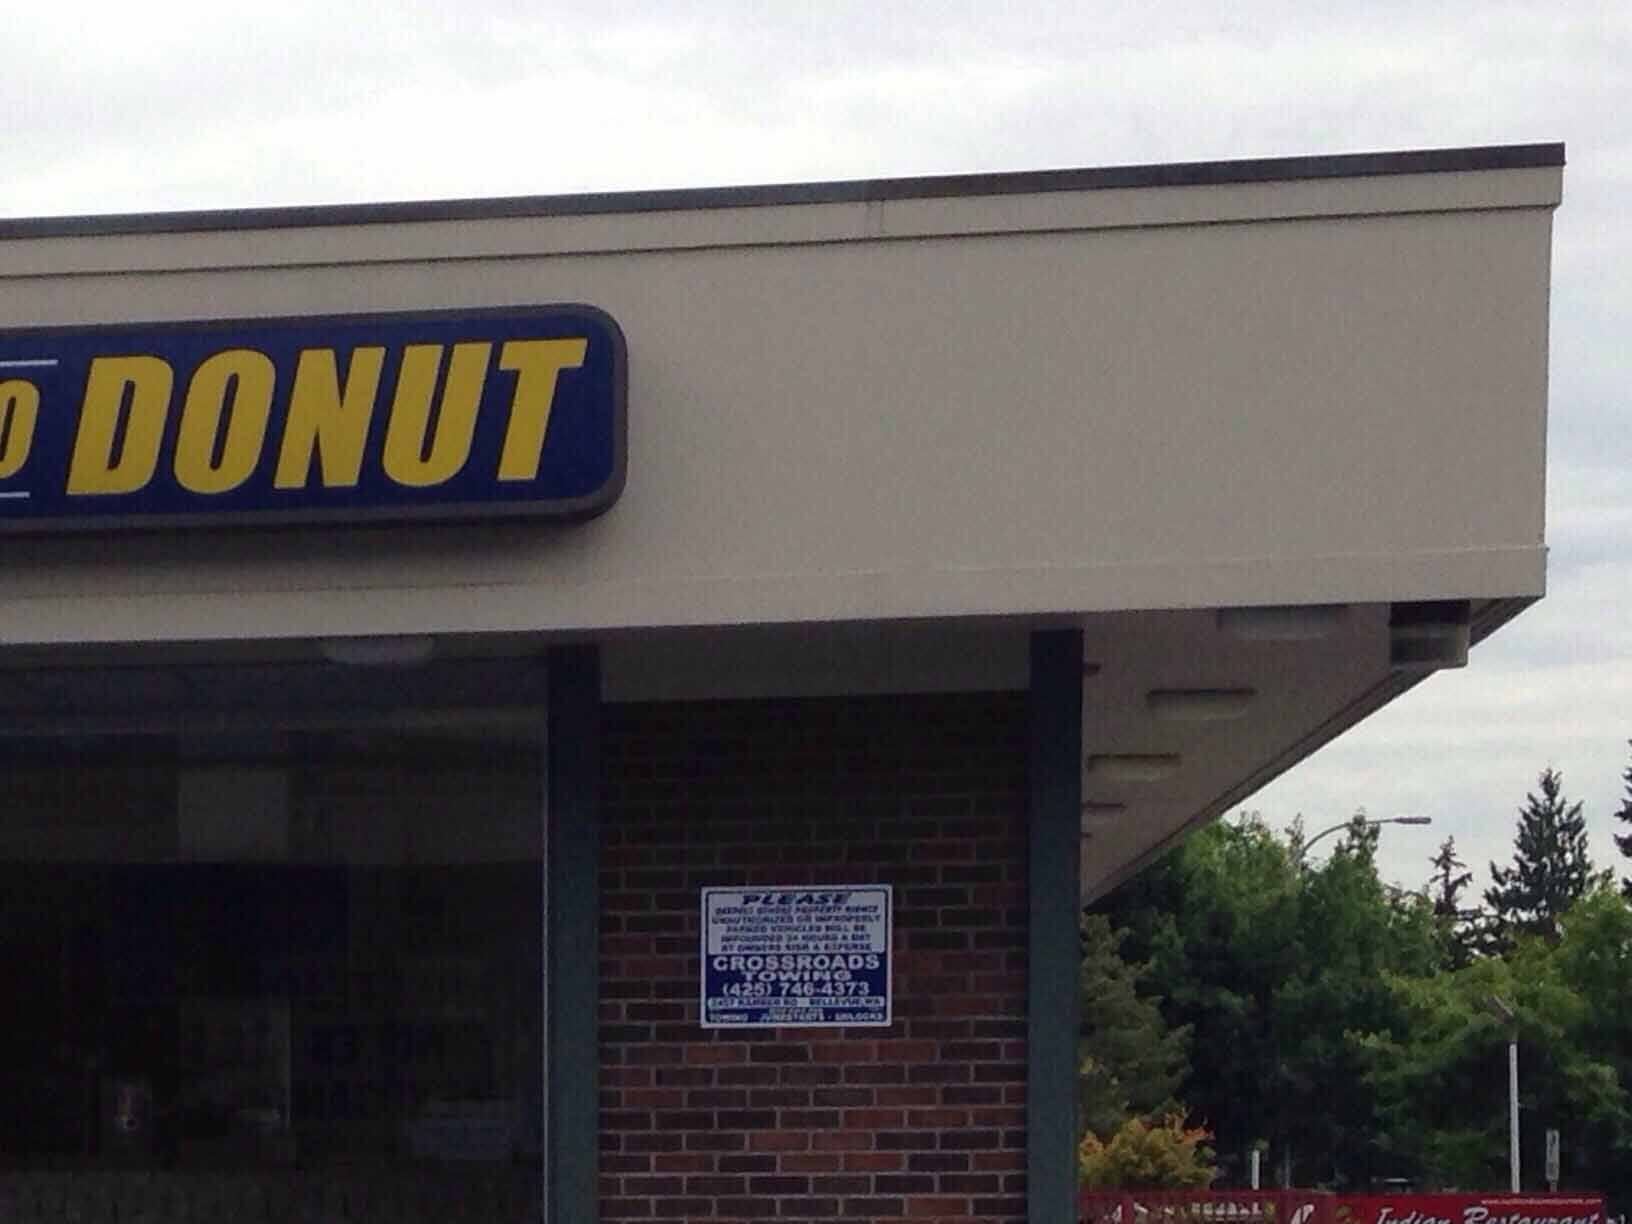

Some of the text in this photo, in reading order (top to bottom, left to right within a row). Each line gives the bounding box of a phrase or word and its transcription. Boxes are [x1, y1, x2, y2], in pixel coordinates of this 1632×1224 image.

[65, 337, 588, 496] DONUT
[742, 893, 851, 905] PLEASE
[713, 954, 880, 971] CROSSROADS
[742, 970, 852, 982] TOWING
[723, 982, 772, 996] (425)
